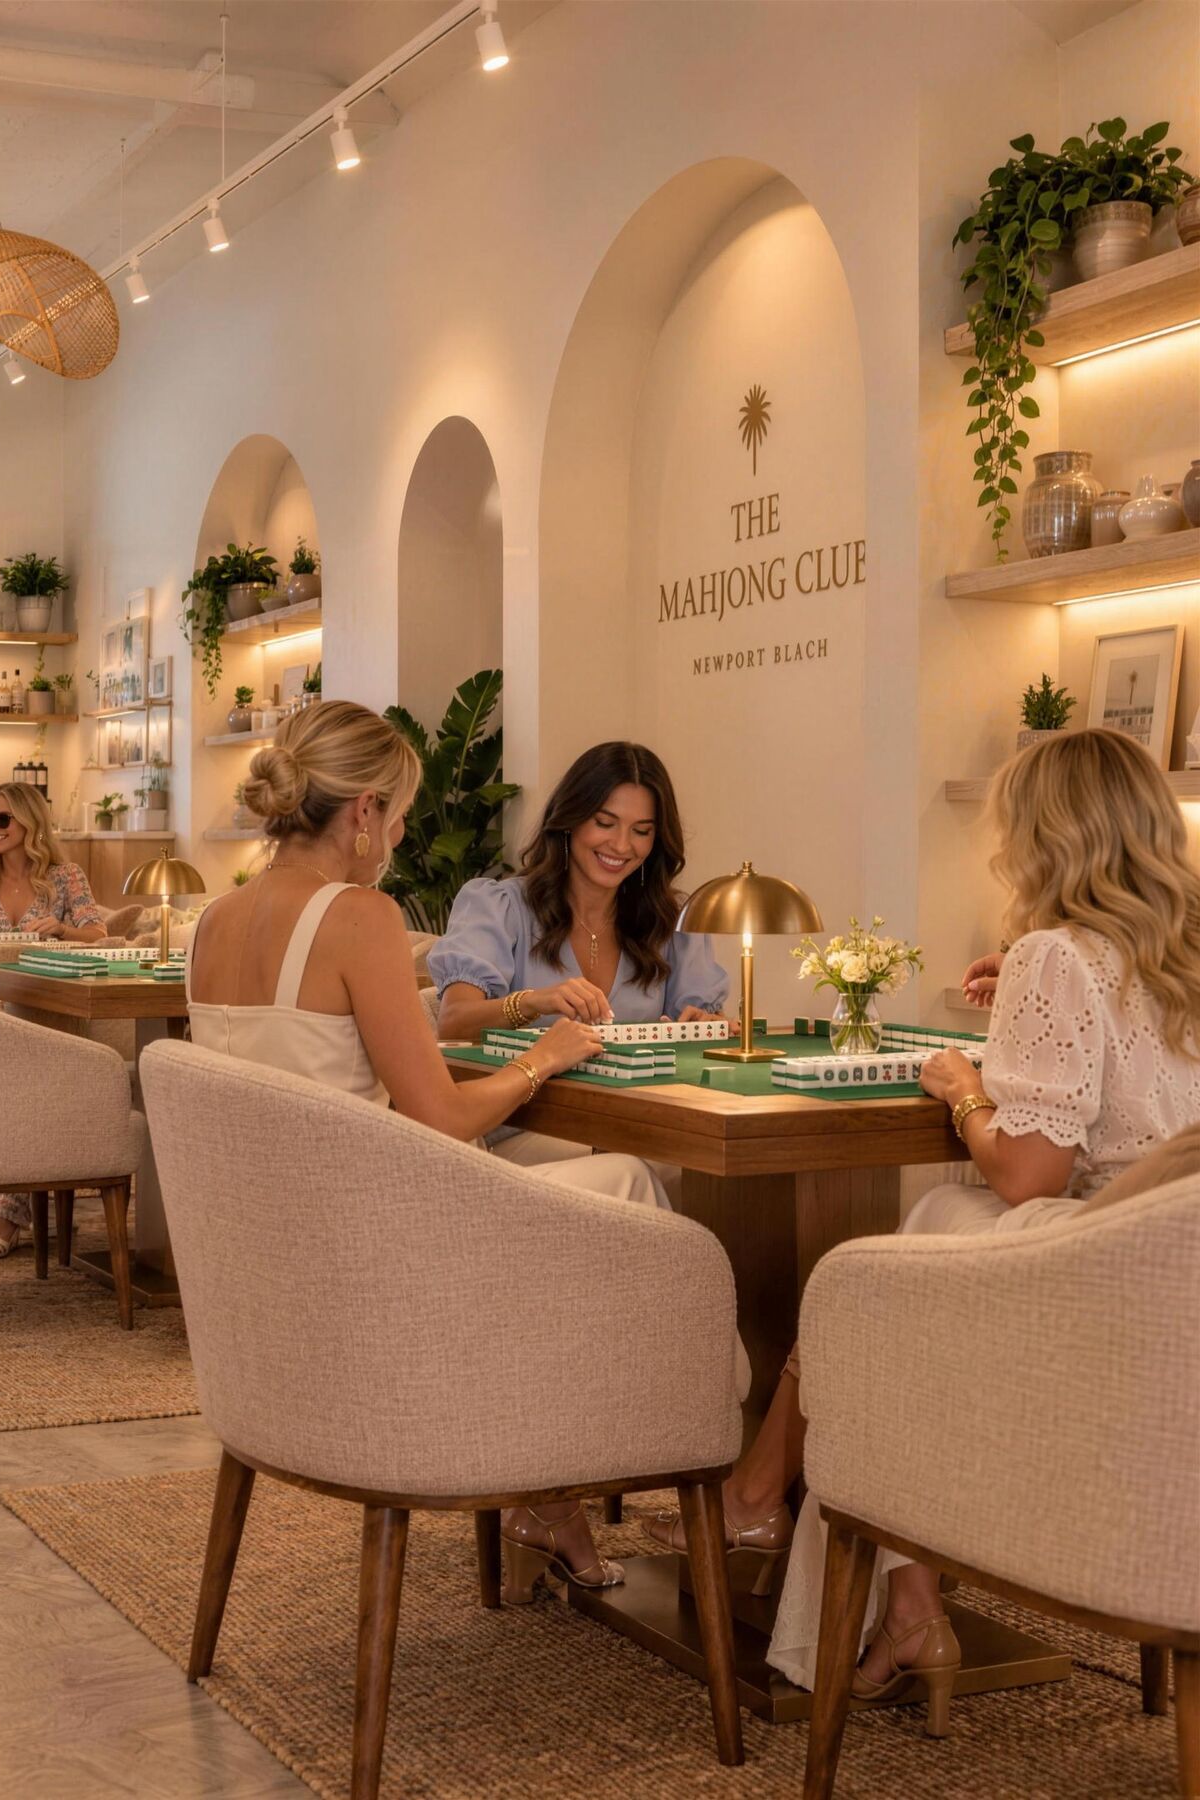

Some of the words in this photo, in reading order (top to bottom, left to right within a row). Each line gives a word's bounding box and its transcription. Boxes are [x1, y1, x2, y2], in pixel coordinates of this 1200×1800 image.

[730, 493, 780, 543] THE
[658, 557, 786, 623] MAHJONG
[693, 648, 766, 675] NEWPORT
